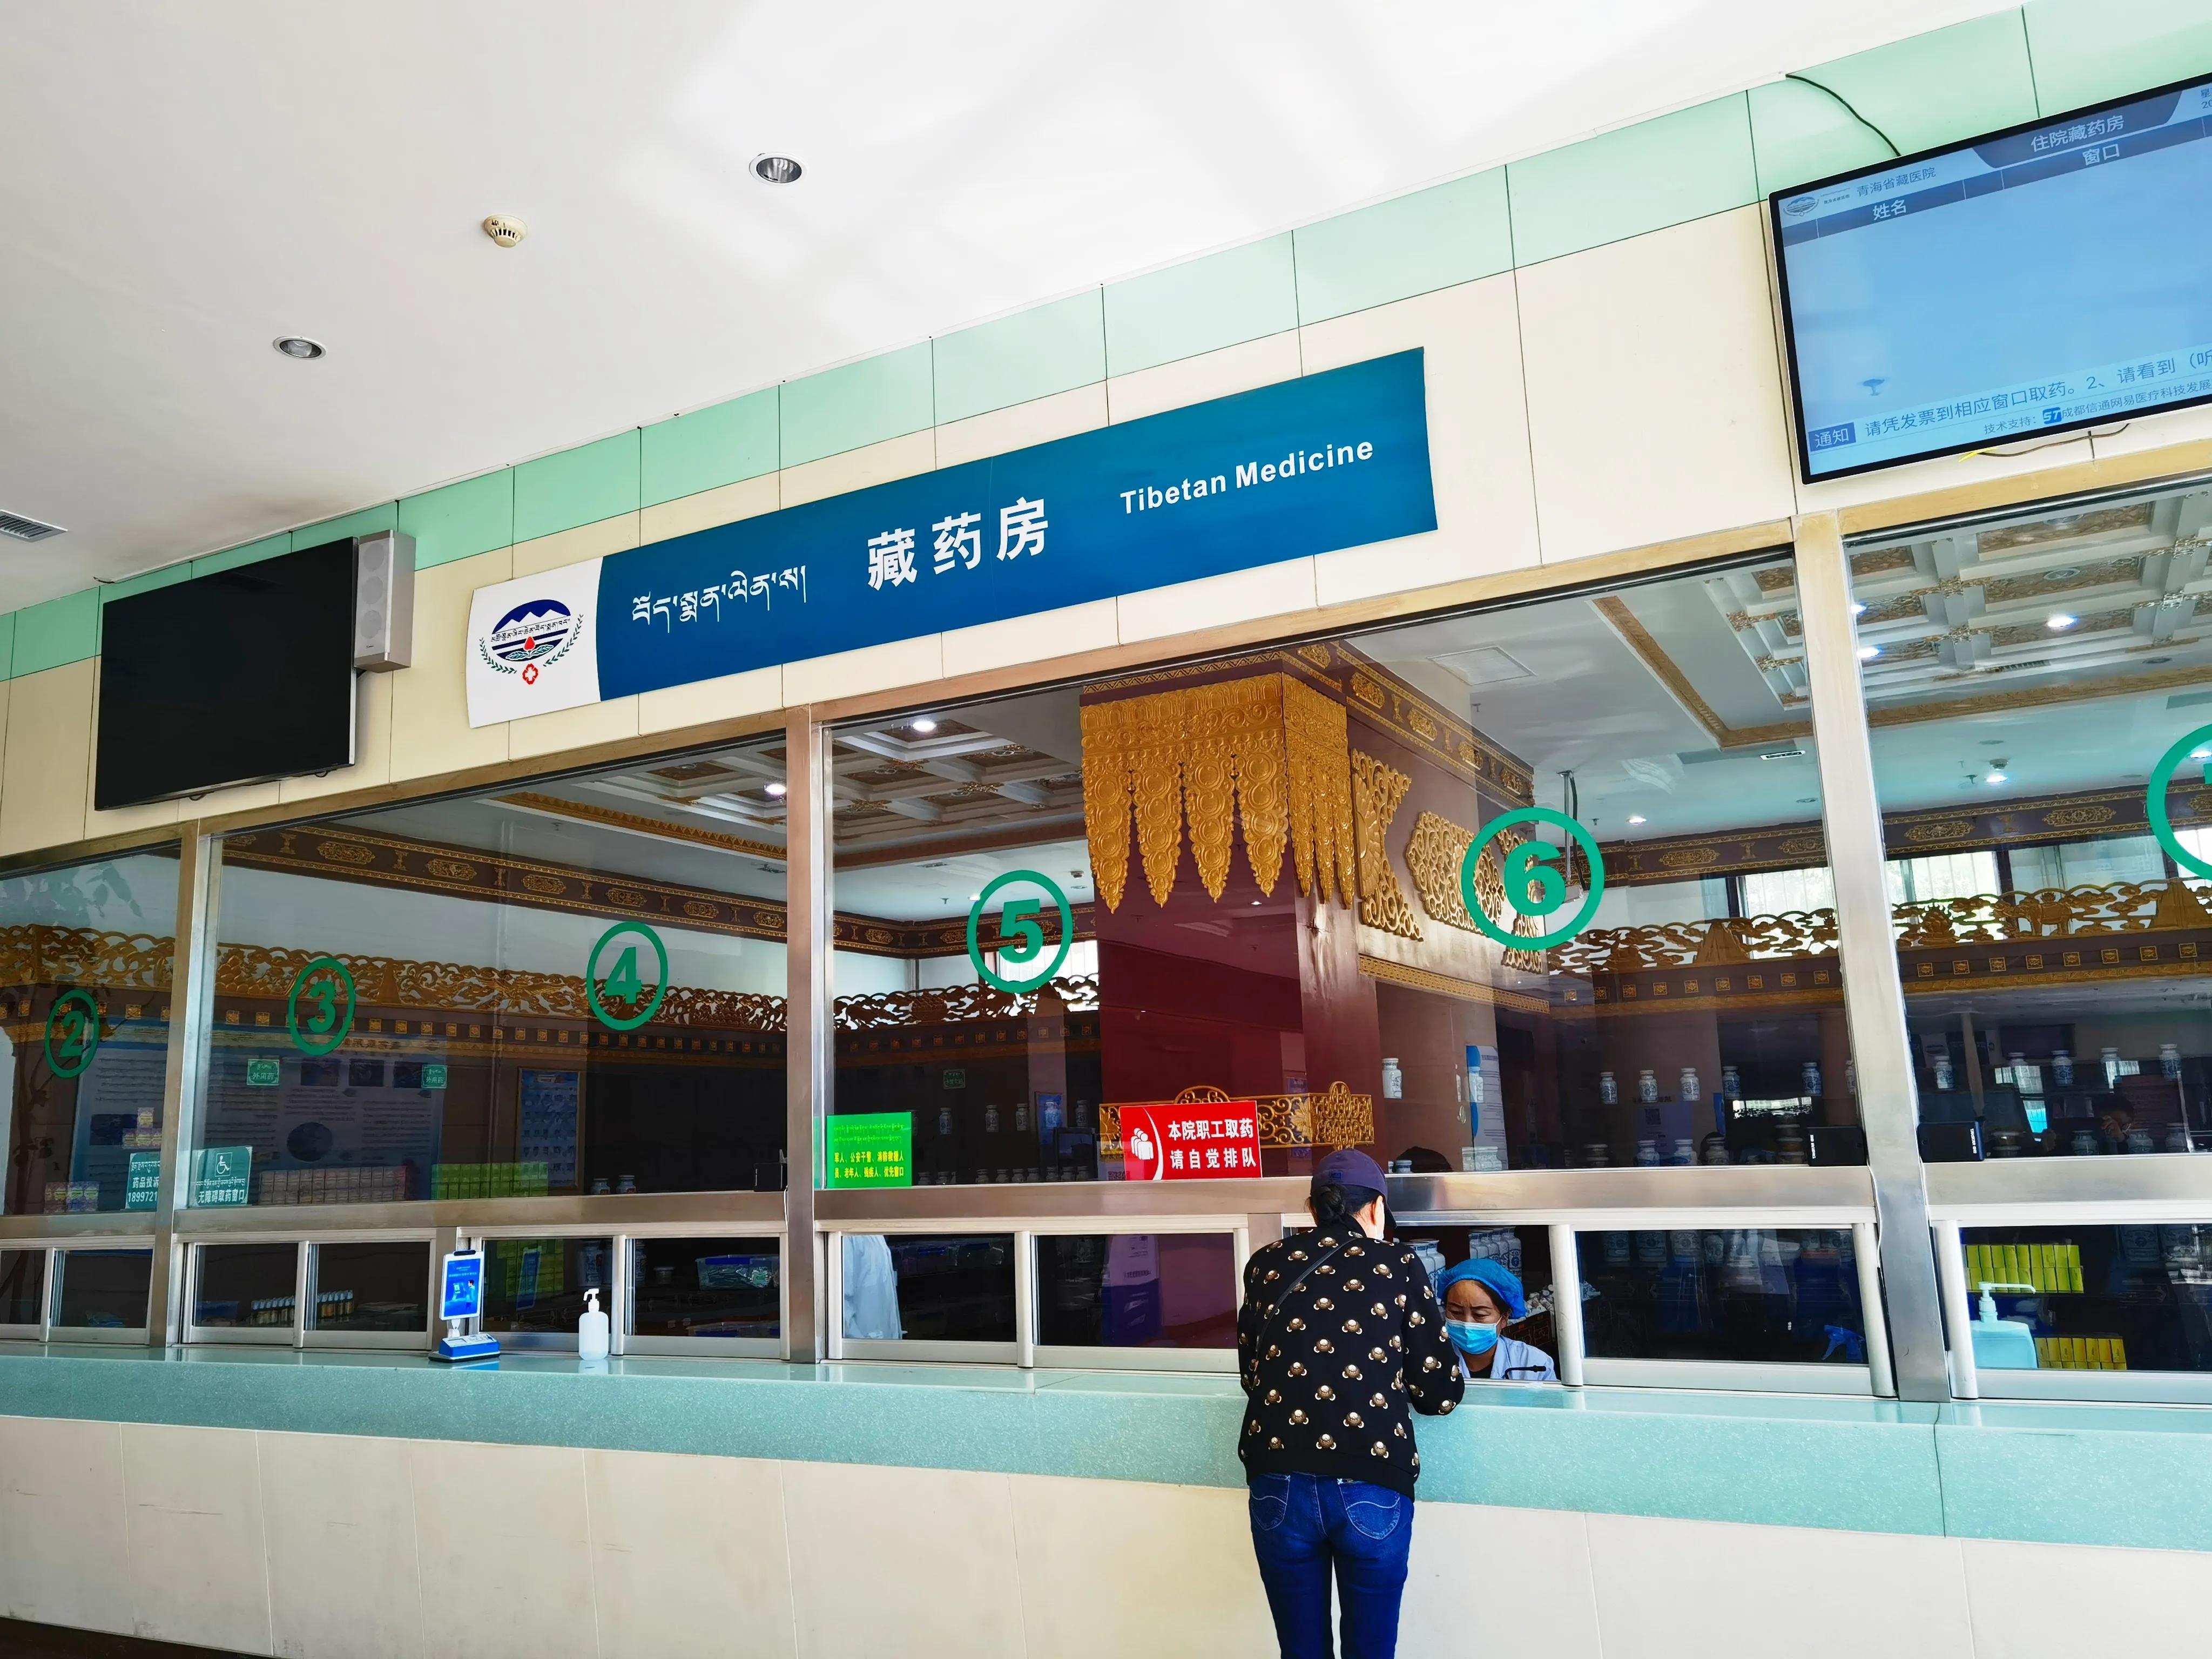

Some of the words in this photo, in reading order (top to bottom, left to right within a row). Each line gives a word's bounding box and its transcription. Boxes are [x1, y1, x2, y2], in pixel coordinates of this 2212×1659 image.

[2031, 114, 2125, 152] 住院藏药房
[2082, 143, 2120, 166] 窗口
[1857, 167, 1936, 197] 青海省藏医院
[1872, 199, 1907, 220] 姓名
[1815, 428, 1850, 448] 通知
[1120, 474, 1227, 515] Tibetan
[1235, 441, 1374, 488] Medicine
[867, 496, 1049, 591] 藏药房
[1168, 1117, 1253, 1141] 本院职工取药
[1170, 1147, 1257, 1169] 请自觉排队
[198, 1188, 245, 1204] 无障碍取药窗口
